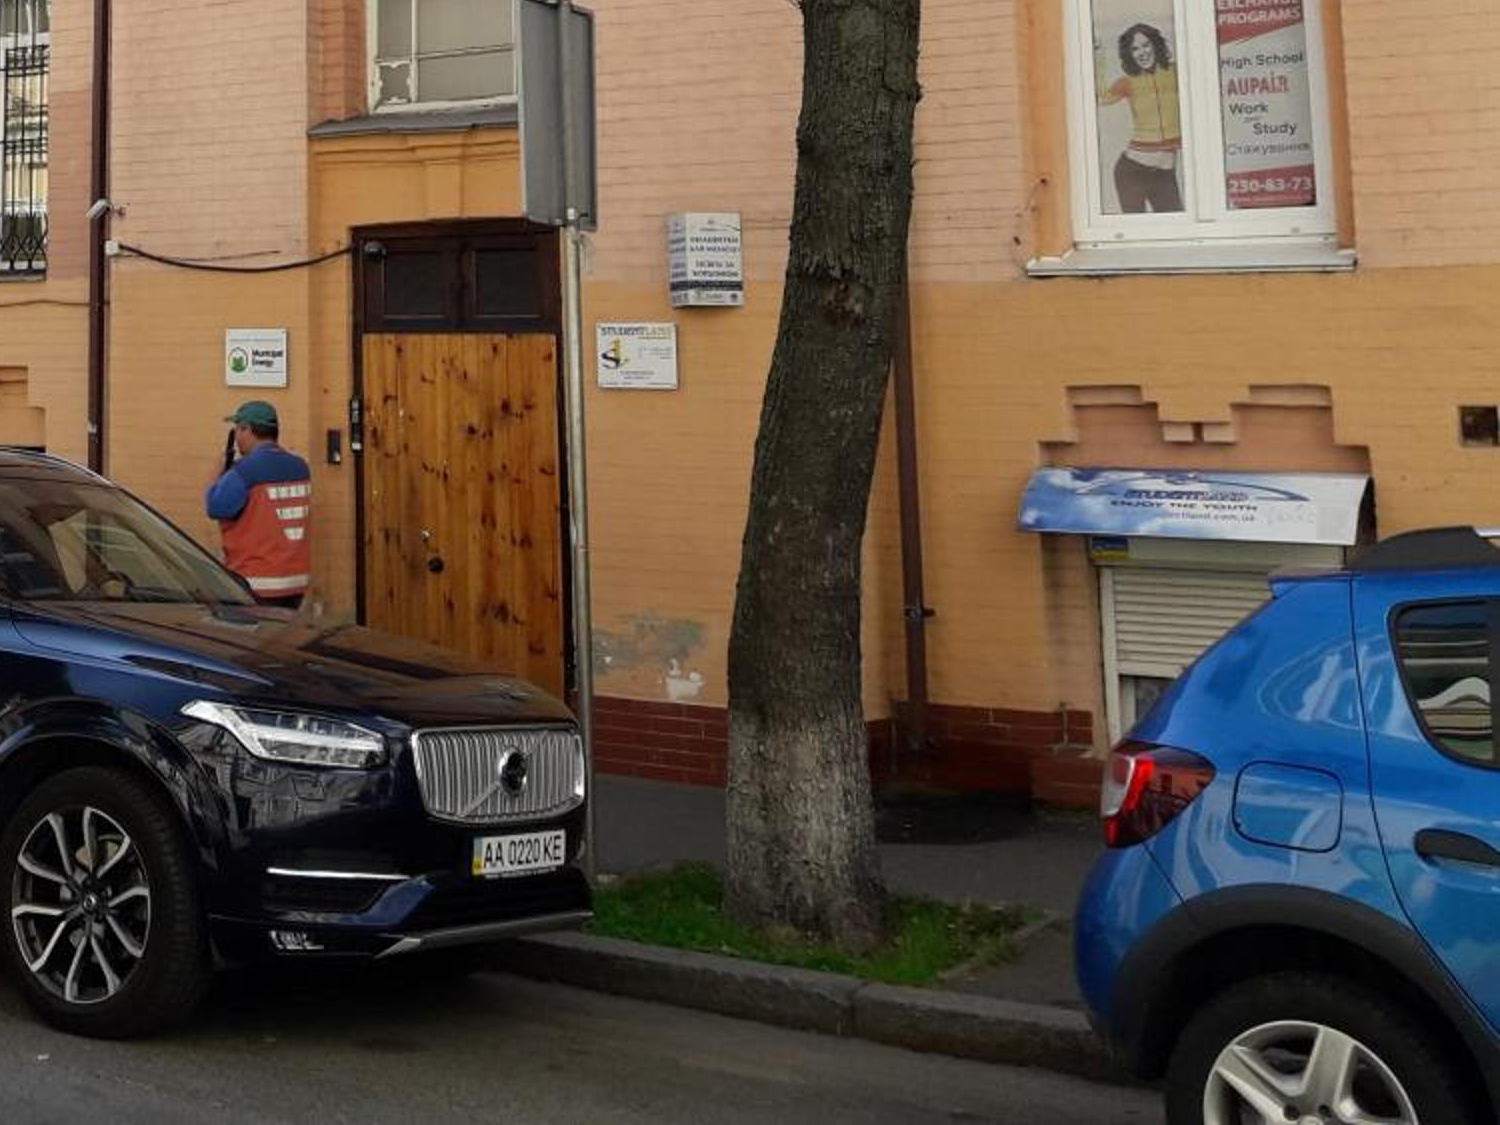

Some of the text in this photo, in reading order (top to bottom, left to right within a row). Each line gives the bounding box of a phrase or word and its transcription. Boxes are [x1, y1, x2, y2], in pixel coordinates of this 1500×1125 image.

[1219, 9, 1301, 25] PROGRAMS
[1221, 50, 1303, 69] High School
[1228, 102, 1269, 115] Work
[1252, 122, 1297, 136] Study
[1111, 500, 1164, 508] ENJOY
[1203, 503, 1257, 511] YOUTH
[484, 835, 562, 868] AA 0220 KE
